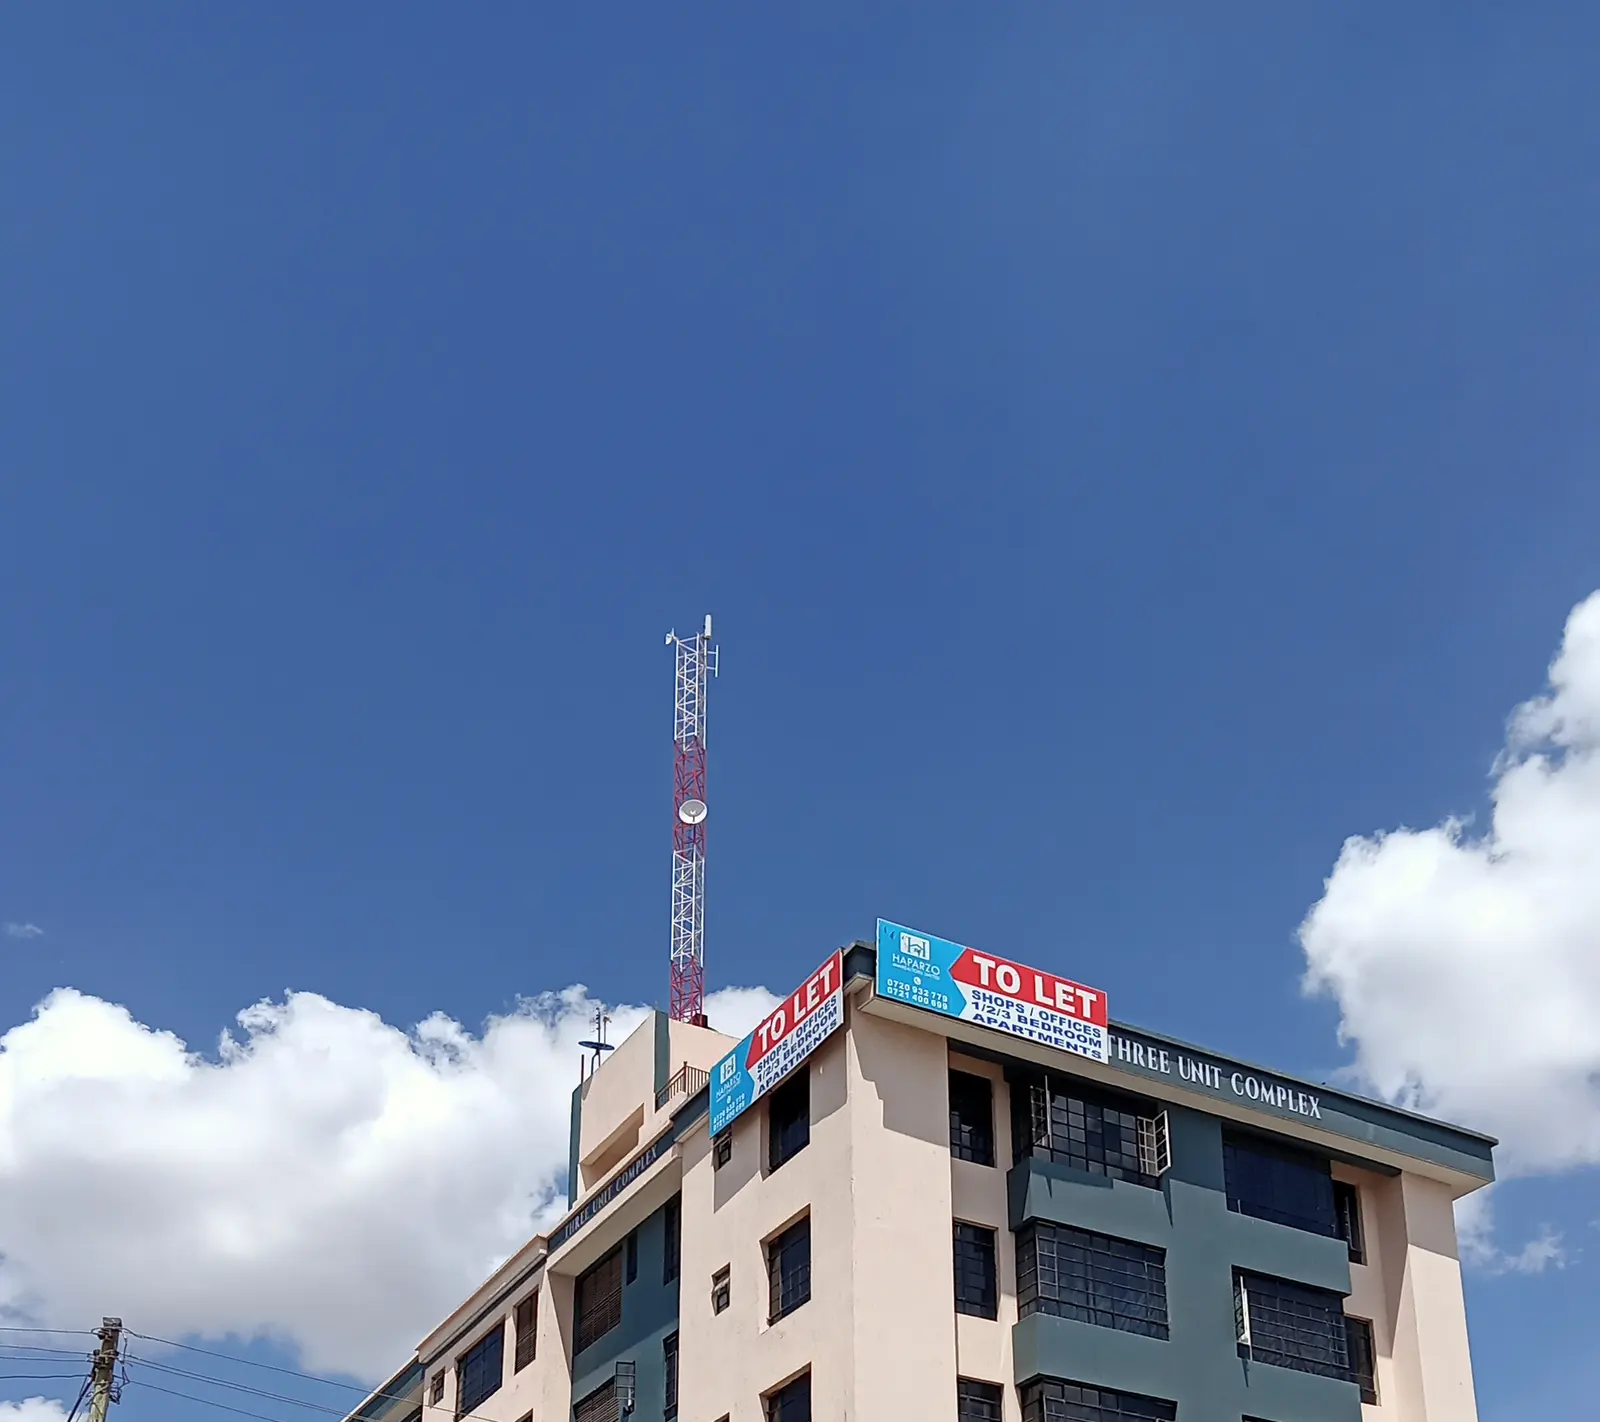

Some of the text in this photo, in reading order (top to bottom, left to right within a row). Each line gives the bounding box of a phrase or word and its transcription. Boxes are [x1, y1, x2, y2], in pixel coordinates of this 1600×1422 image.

[887, 978, 910, 991] 0720
[887, 986, 909, 999] 0721
[892, 953, 940, 976] HAPARZO
[973, 954, 1020, 994] TO
[1034, 974, 1096, 1018] LET
[757, 960, 835, 1052] TO LET
[757, 1038, 788, 1074] SHOPS
[795, 994, 837, 1038] OFFICES
[971, 989, 1025, 1014] SHOPS
[1039, 1010, 1101, 1038] OFFICES
[971, 1001, 1102, 1049] 1/2/3 BEDROOM
[972, 1013, 1102, 1059] APARTMENTS
[757, 1005, 838, 1083] 1/2/3 BEDROOM
[757, 1018, 838, 1096] APARTMENTS
[1108, 1033, 1322, 1120] THREE UNIT COMPLEX
[564, 1144, 658, 1239] THREE UNIT COMPLEX
